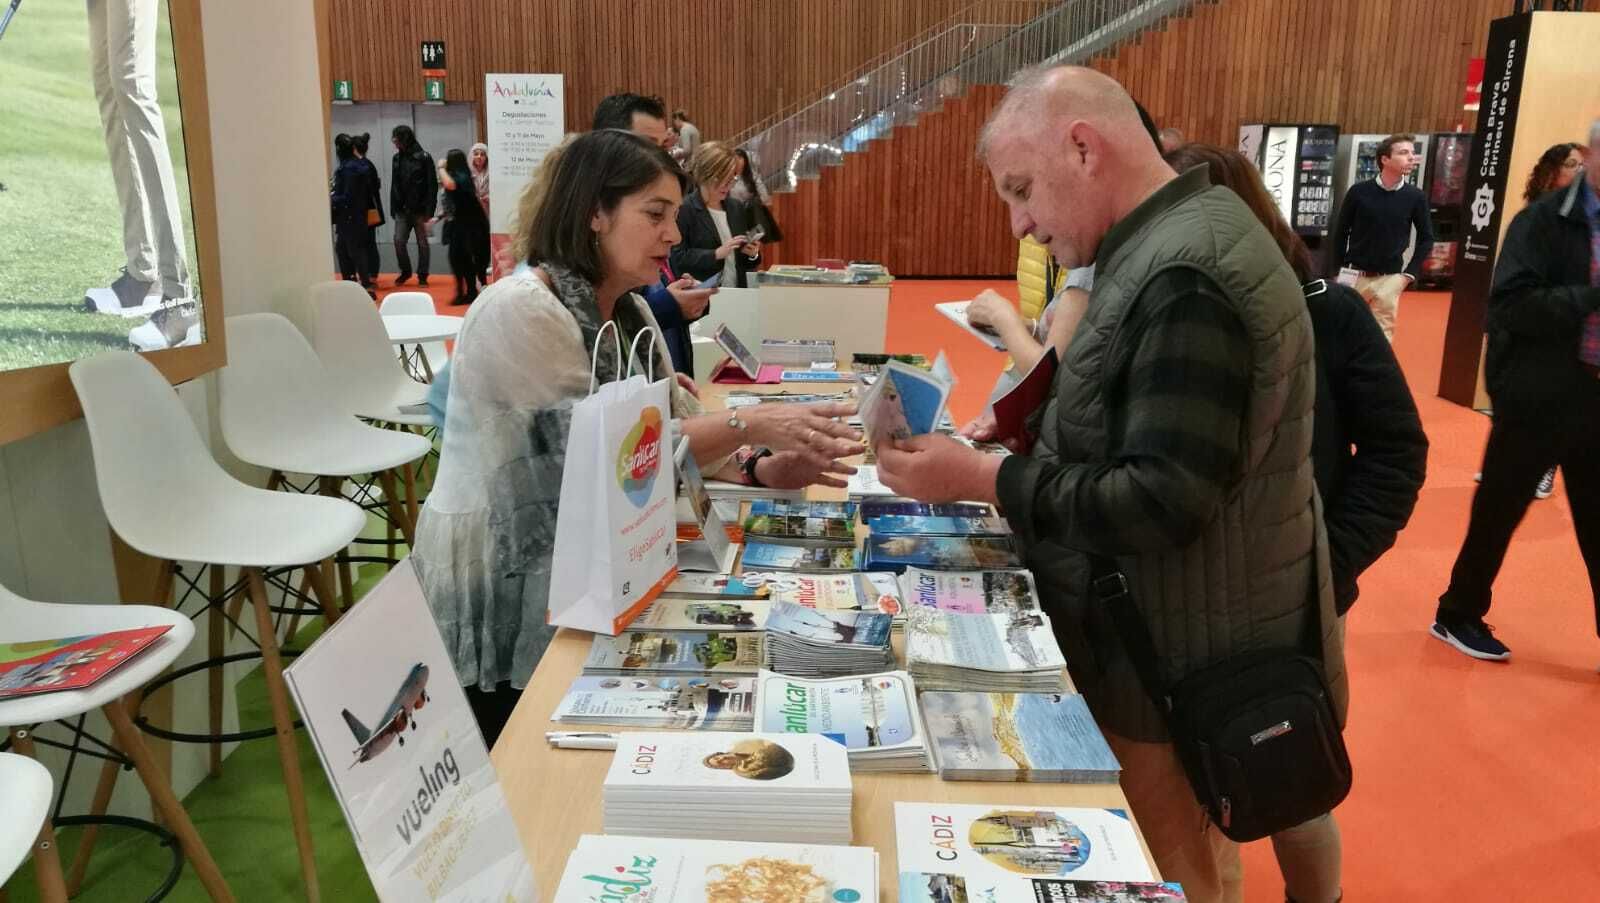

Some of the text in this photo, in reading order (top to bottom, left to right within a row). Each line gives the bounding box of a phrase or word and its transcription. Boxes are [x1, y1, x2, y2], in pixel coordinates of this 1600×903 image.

[1480, 81, 1501, 177] Costa Brava
[1489, 39, 1517, 177] Pirineu de Girona
[780, 682, 809, 733] anlúcar
[395, 746, 461, 845] vueling
[631, 743, 657, 775] CÁDIZ
[932, 815, 958, 861] CÁDIZ
